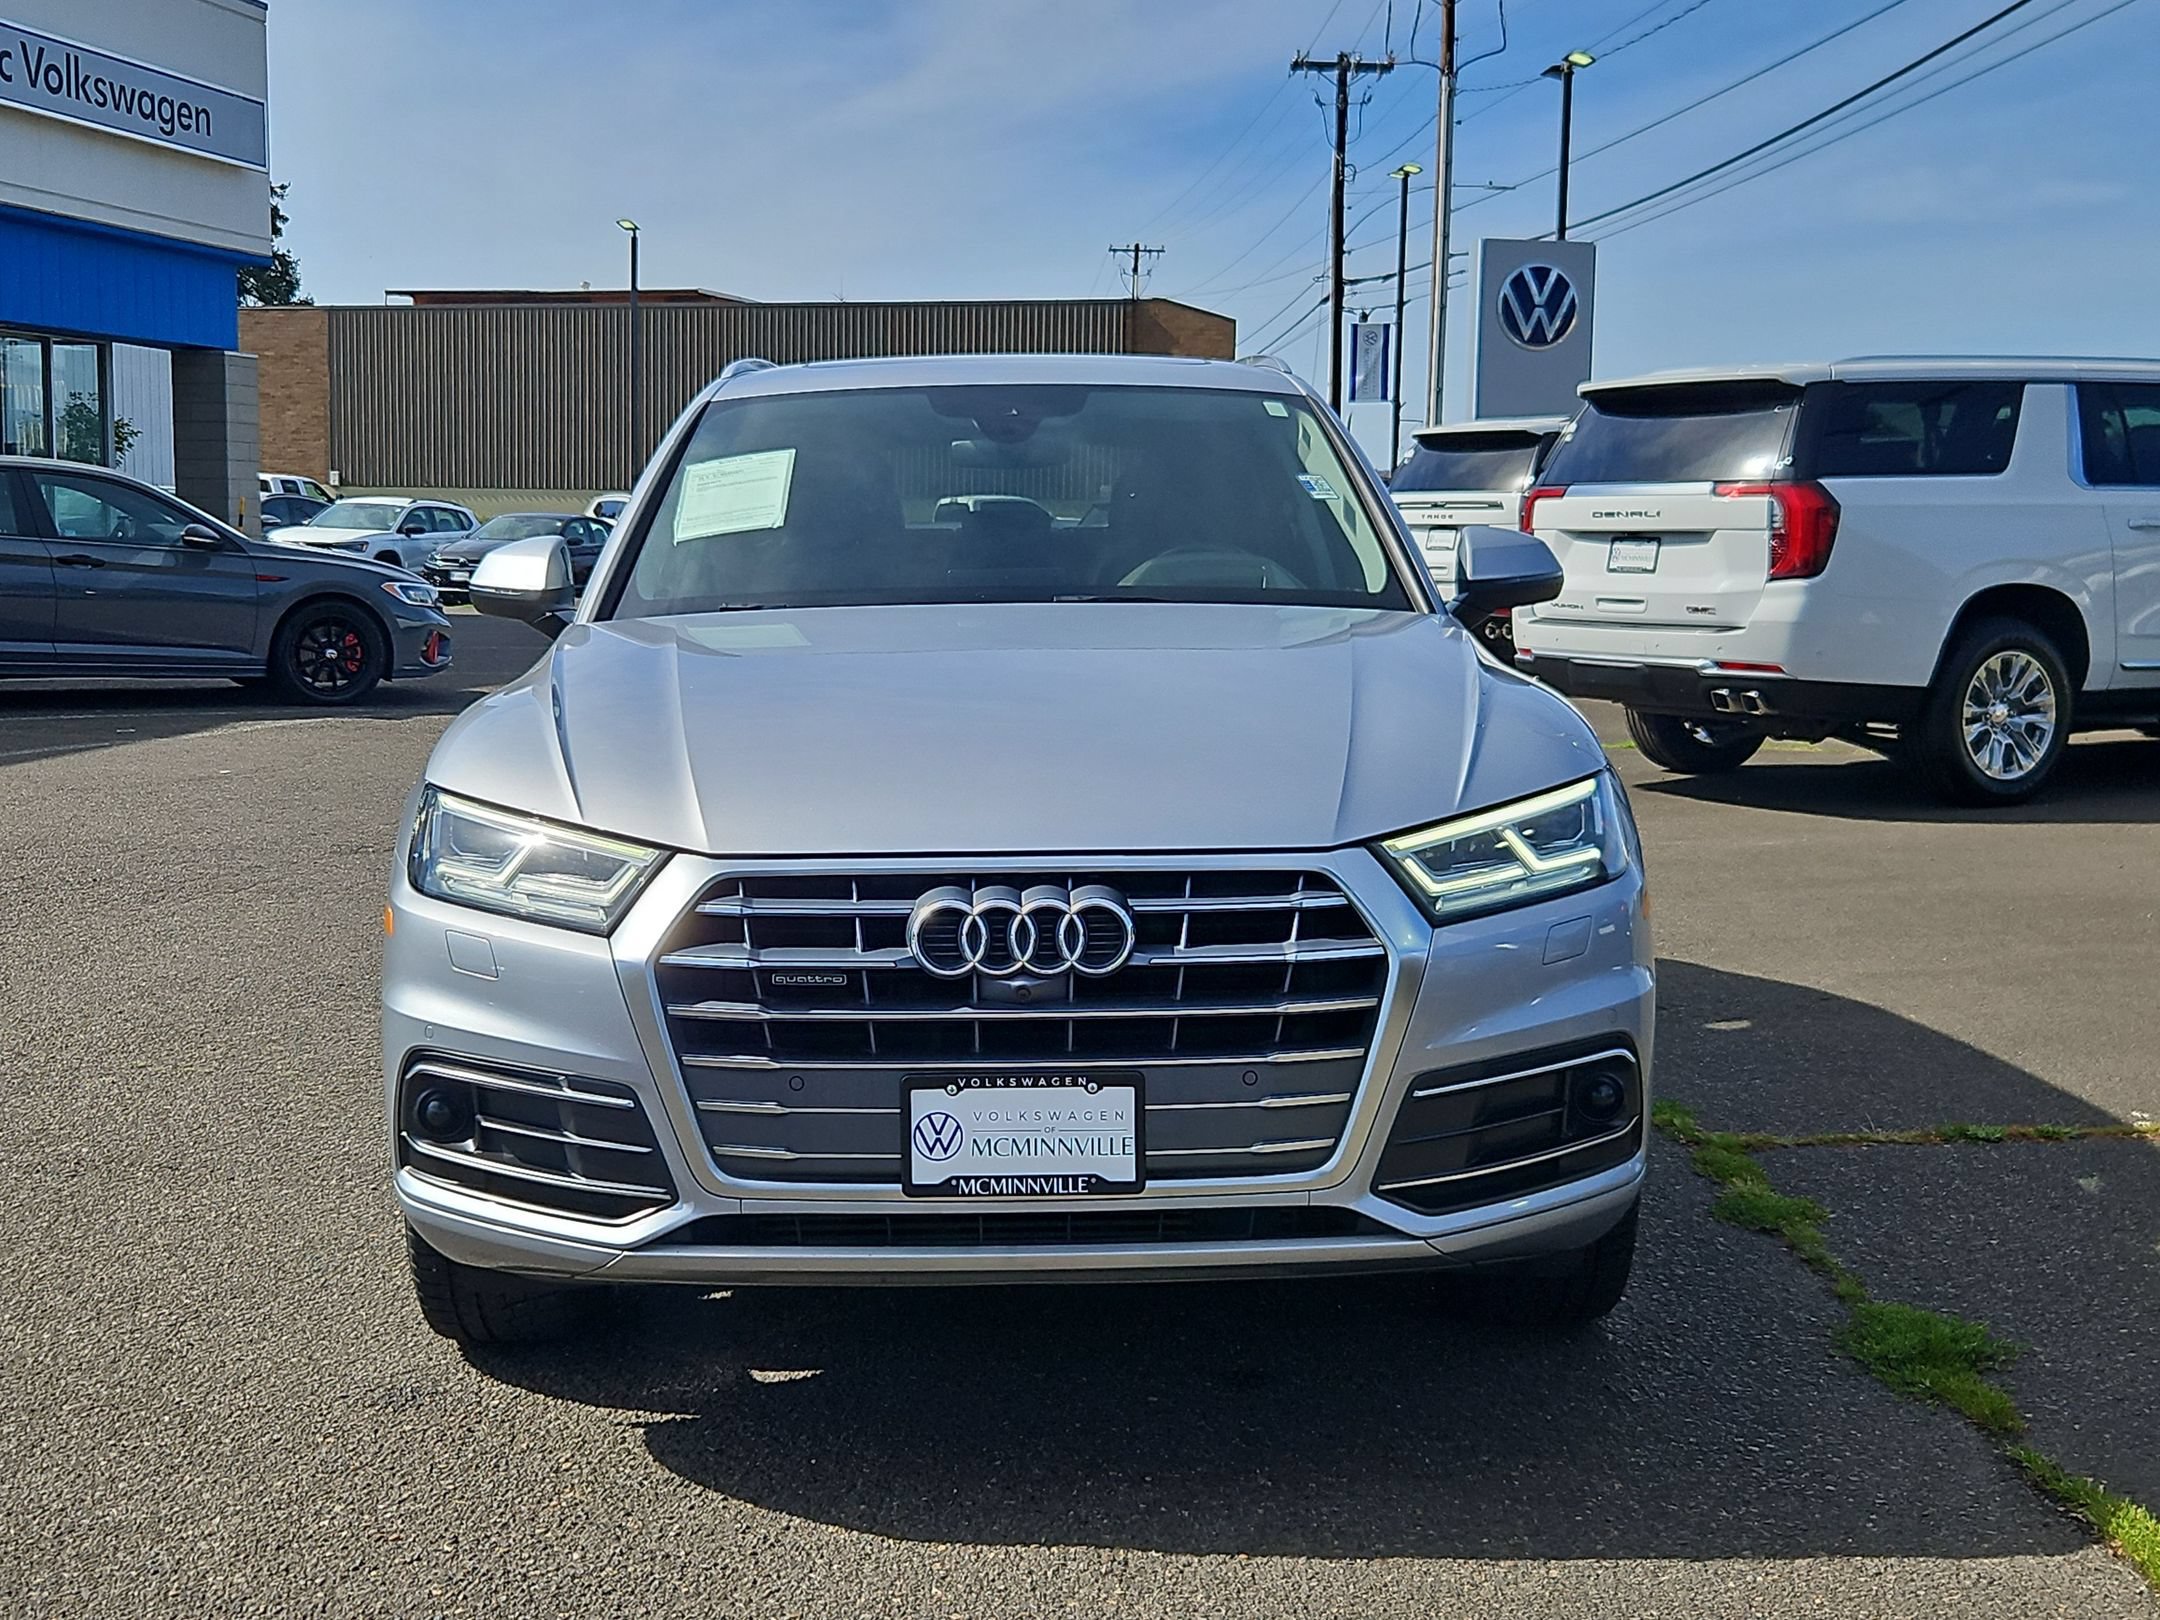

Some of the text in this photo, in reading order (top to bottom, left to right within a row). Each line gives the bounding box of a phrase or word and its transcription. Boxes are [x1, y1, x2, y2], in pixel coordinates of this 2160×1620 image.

[19, 40, 212, 137] Volkswagen
[1592, 511, 1661, 519] DENALI
[775, 975, 843, 985] quattro
[958, 1077, 1087, 1088] VOLKSWAGEN
[973, 1110, 1125, 1122] VOLKSWAGEN
[1044, 1126, 1056, 1134] OF
[972, 1136, 1134, 1157] MCMINNVILLE
[958, 1177, 1089, 1195] MCMINNVILLE
